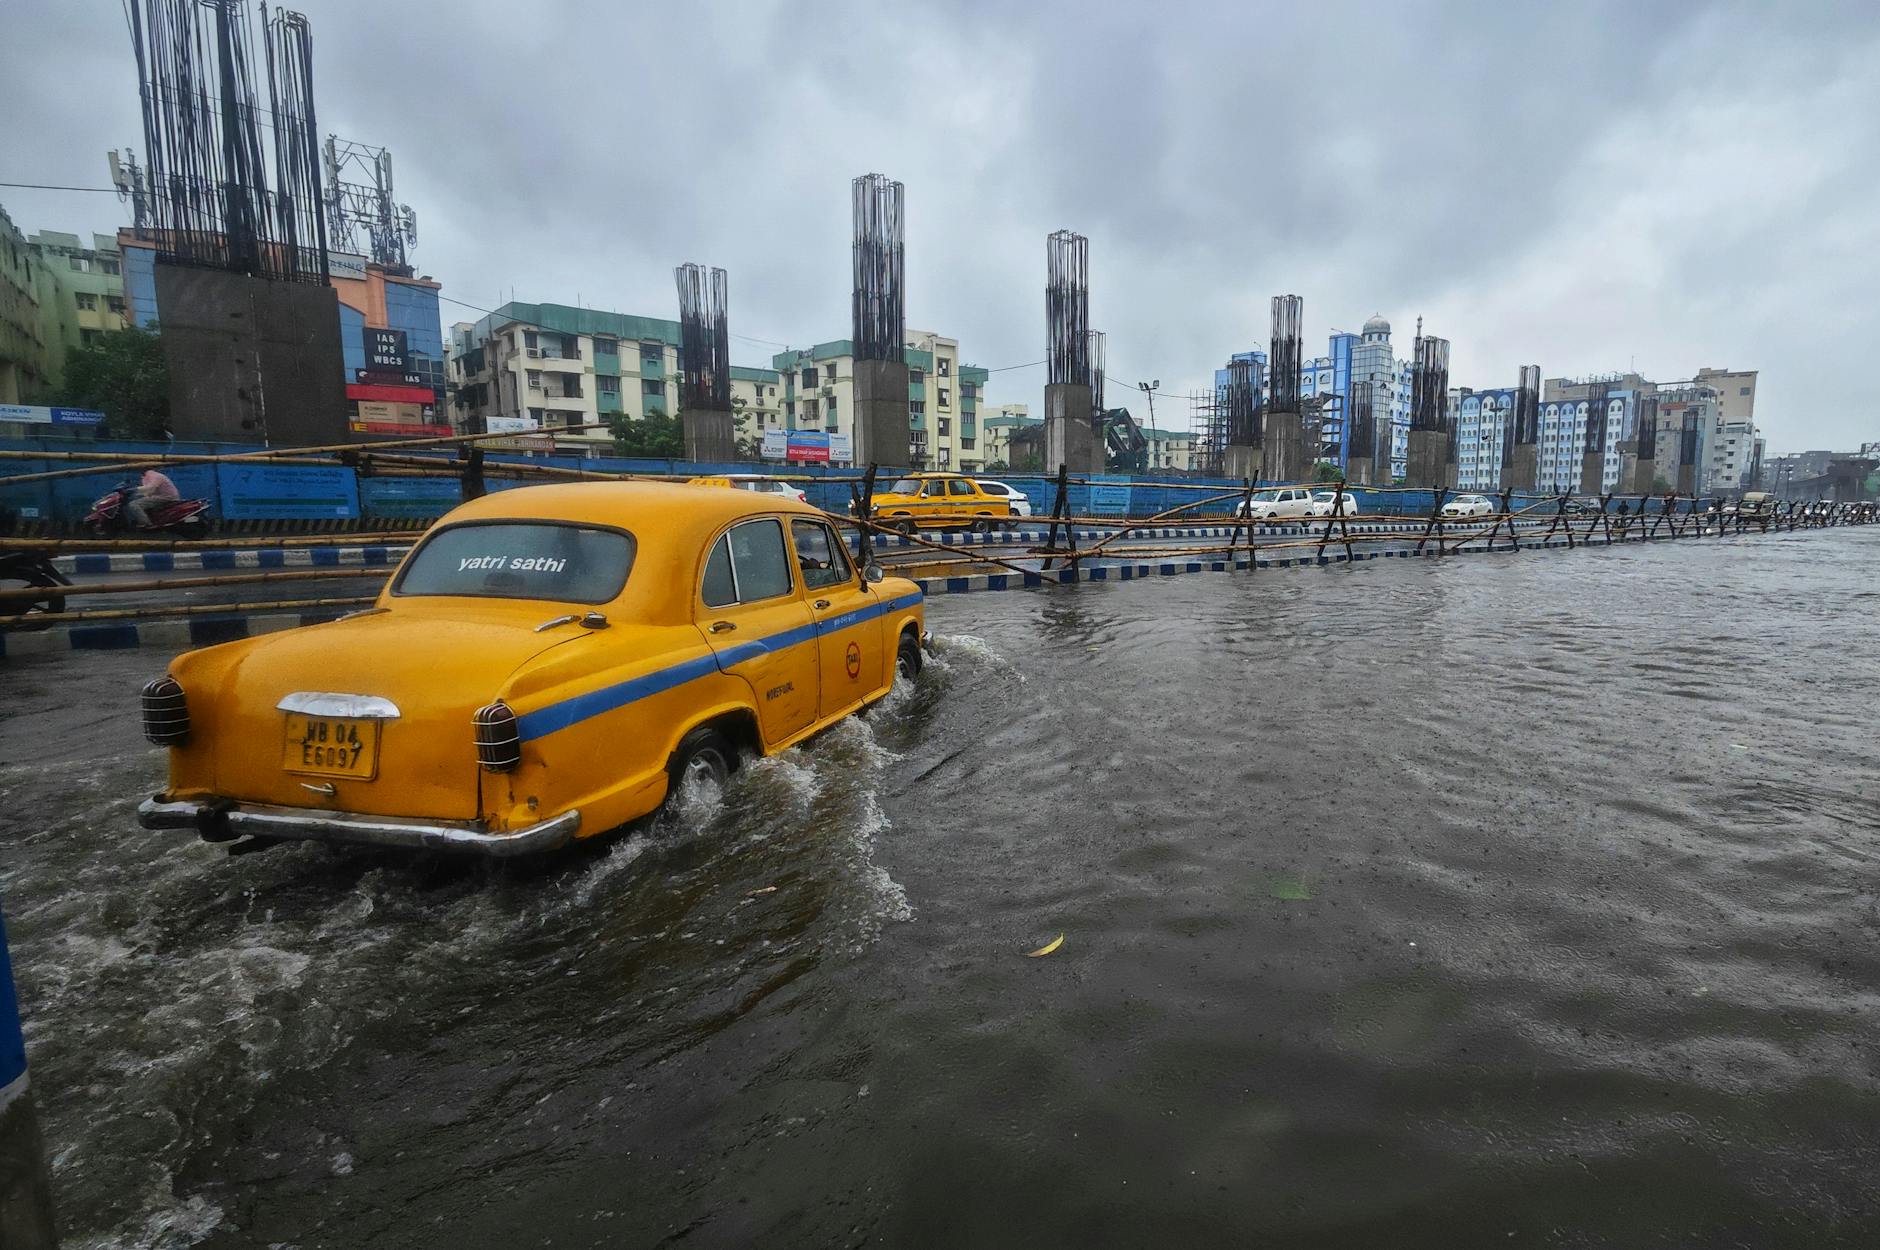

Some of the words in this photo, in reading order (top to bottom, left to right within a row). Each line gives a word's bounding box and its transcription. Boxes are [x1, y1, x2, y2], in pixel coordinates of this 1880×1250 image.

[377, 333, 395, 343] IAS
[378, 345, 396, 354] IPS
[374, 355, 402, 365] WBCS
[405, 375, 420, 383] IAS
[458, 556, 507, 571] yatri
[510, 556, 567, 572] sathi
[303, 744, 362, 769] E6097
